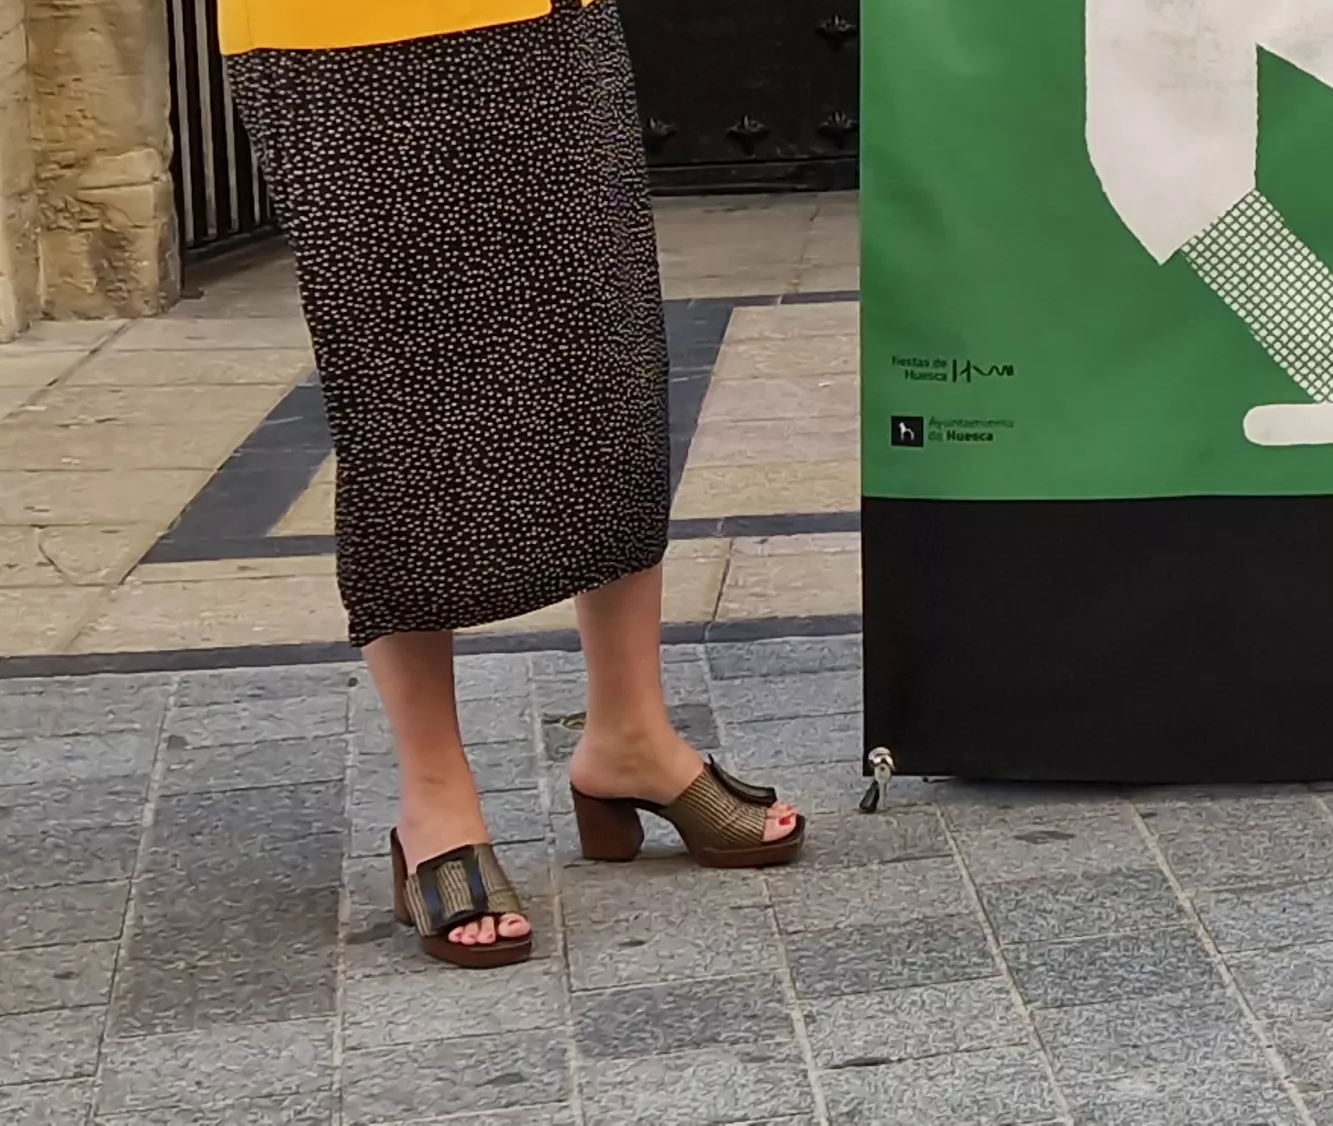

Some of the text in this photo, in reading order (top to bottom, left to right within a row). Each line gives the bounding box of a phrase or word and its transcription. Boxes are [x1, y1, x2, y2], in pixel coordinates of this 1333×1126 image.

[932, 356, 948, 369] de
[904, 369, 948, 382] Huesca
[928, 429, 994, 442] de Huesca
